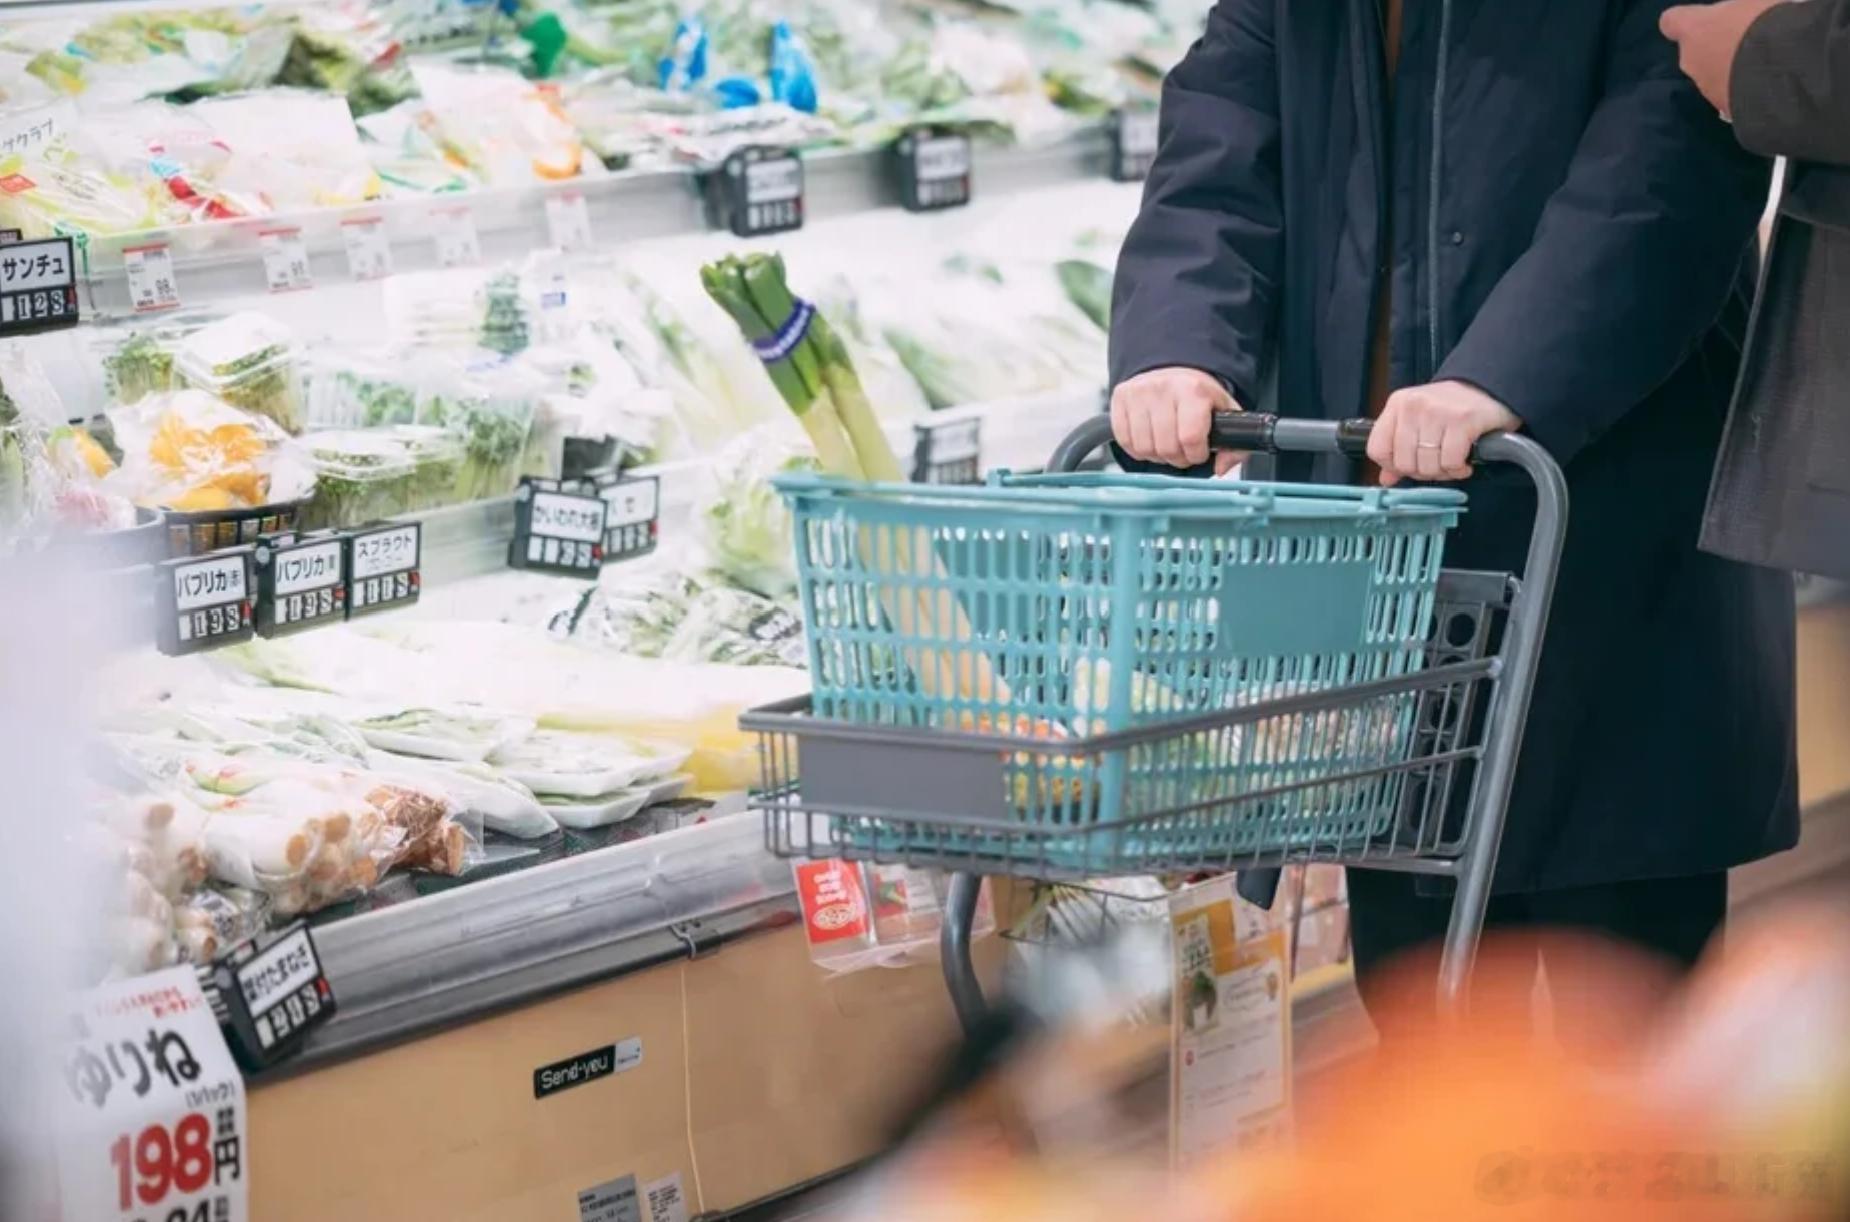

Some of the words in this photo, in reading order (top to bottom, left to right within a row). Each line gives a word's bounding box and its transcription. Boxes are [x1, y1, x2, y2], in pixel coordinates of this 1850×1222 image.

[2, 254, 65, 282] サンチュ
[17, 290, 64, 318] 128
[357, 535, 413, 558] スプラウト
[194, 604, 239, 637] 198
[62, 1027, 201, 1111] ゆりね
[110, 1112, 213, 1211] 198
[214, 1135, 240, 1186] 円
